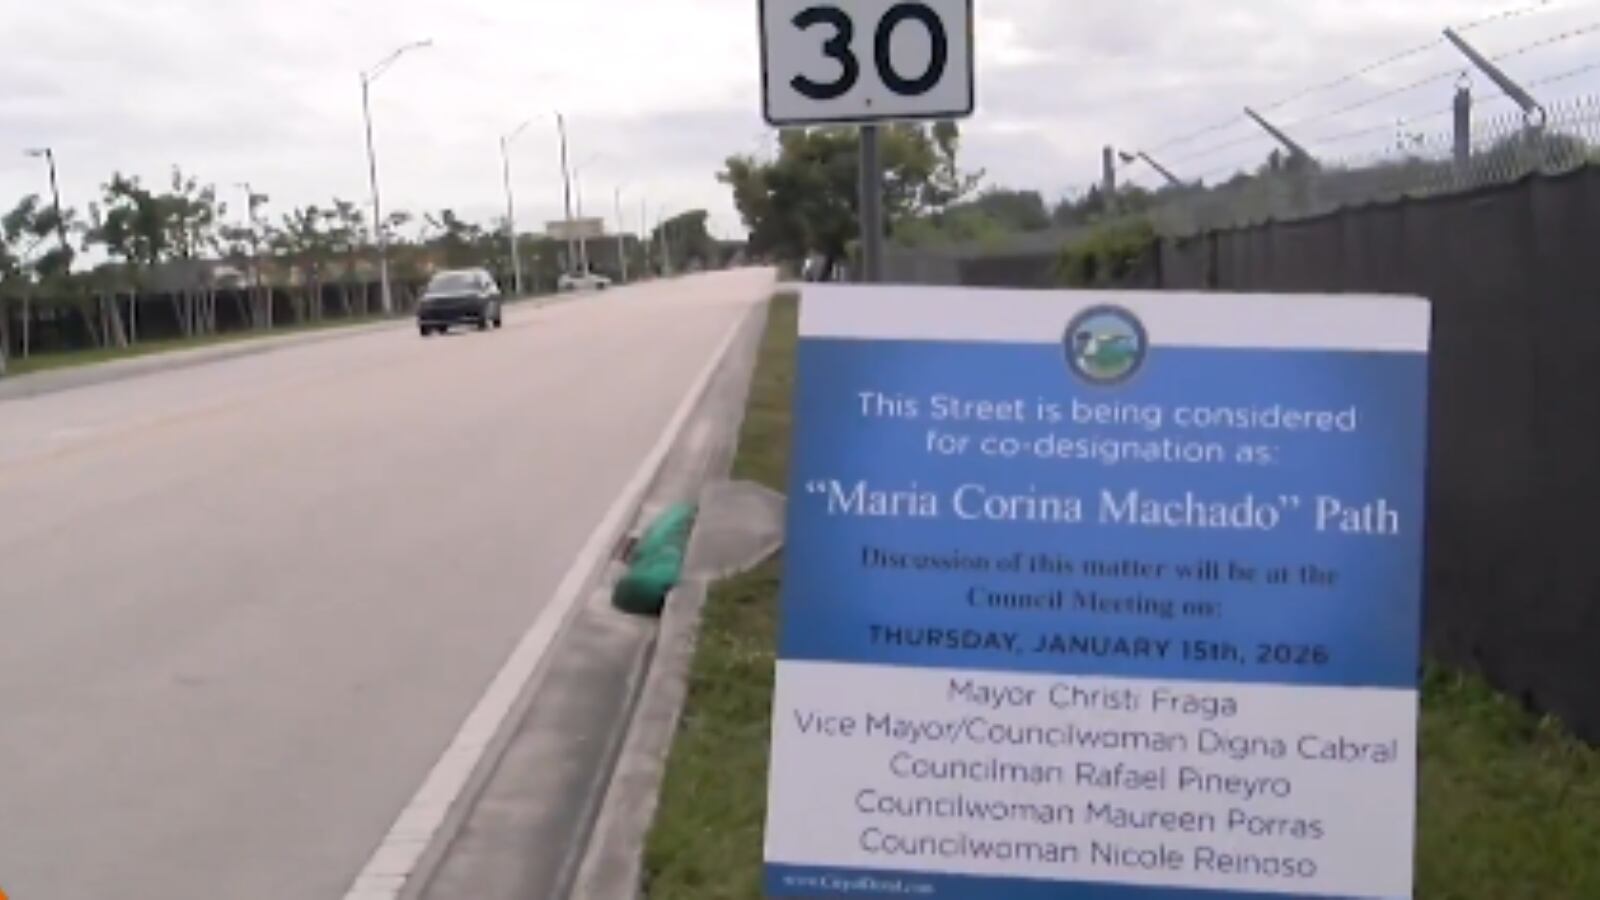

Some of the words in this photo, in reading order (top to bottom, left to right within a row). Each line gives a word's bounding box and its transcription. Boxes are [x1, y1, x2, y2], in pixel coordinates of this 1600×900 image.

[790, 3, 948, 99] 30
[858, 390, 918, 417] This
[930, 392, 1024, 421] Street
[1037, 395, 1061, 420] is
[1072, 396, 1162, 428] being
[1174, 400, 1356, 430] considered
[926, 428, 968, 453] for
[981, 430, 1224, 463] co-designation
[1236, 441, 1279, 463] as:
[953, 483, 1083, 522] Corina
[1315, 497, 1399, 533] Path
[860, 545, 989, 572] Discussion
[996, 550, 1023, 573] of
[1028, 550, 1075, 574] this
[1083, 557, 1166, 578] matter
[1174, 556, 1220, 580] will
[1228, 559, 1258, 582] be
[1265, 564, 1292, 582] at
[1299, 562, 1337, 584] the
[966, 584, 1063, 609] Council
[1072, 587, 1174, 618] Meeting
[1182, 596, 1223, 617] on:
[868, 624, 1022, 653] THURSDAY,
[1032, 633, 1170, 658] JANUARY
[1181, 639, 1246, 663] 15th,
[1257, 642, 1329, 663] 2026
[949, 678, 1035, 709] Mayor
[1049, 681, 1140, 709] Christi
[1152, 687, 1238, 716] Fraga
[794, 710, 856, 735] Vice
[866, 713, 1188, 752] Mayor/Councilwoman
[1198, 730, 1287, 759] Digna
[1297, 733, 1398, 761] Cabral
[890, 751, 1063, 783] Councilman
[1076, 760, 1166, 788] Rafael
[1179, 767, 1291, 798] Pineyro
[855, 788, 1074, 822] Councilwoman
[1087, 801, 1216, 830] Maureen
[1228, 810, 1323, 838] Porras
[859, 827, 1079, 861] Councilwoman
[1092, 838, 1184, 868] Nicole
[1194, 846, 1317, 876] Reinoso
